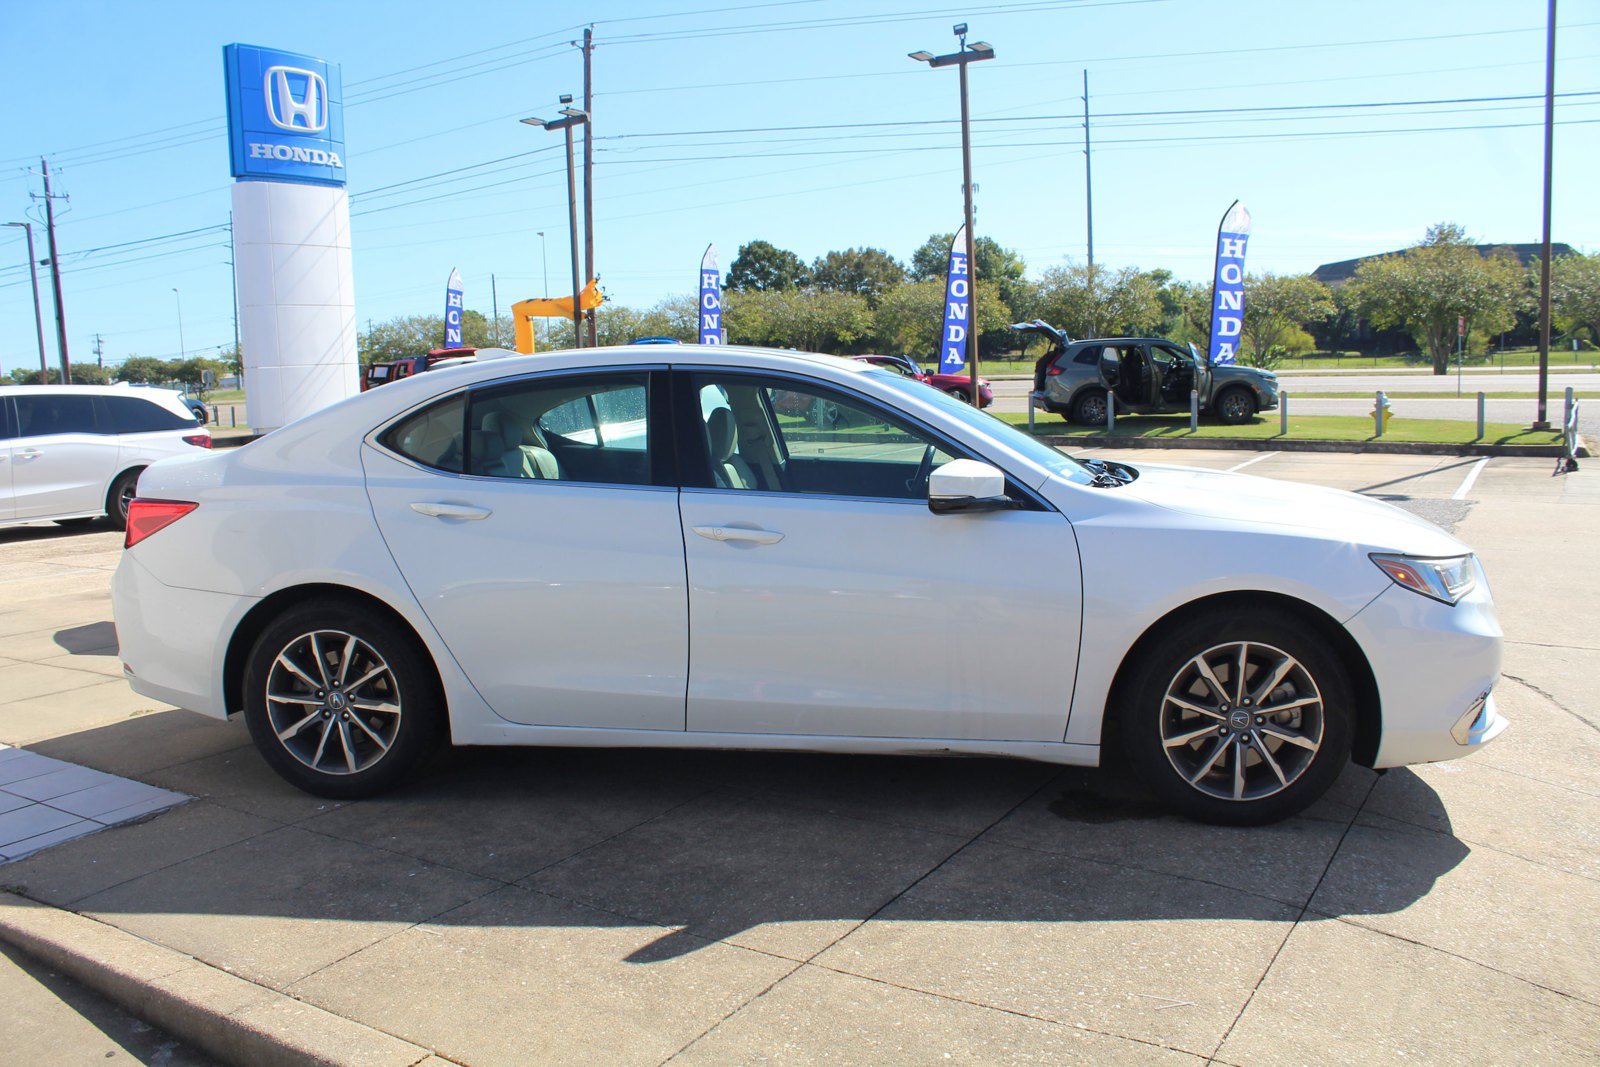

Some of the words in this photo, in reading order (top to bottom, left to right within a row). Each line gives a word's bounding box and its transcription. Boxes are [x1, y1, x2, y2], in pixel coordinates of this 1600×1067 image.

[249, 143, 343, 169] HONDA
[447, 292, 462, 343] HON
[702, 273, 720, 345] HOND
[944, 257, 968, 365] HONDA
[1214, 238, 1246, 363] HONDA
